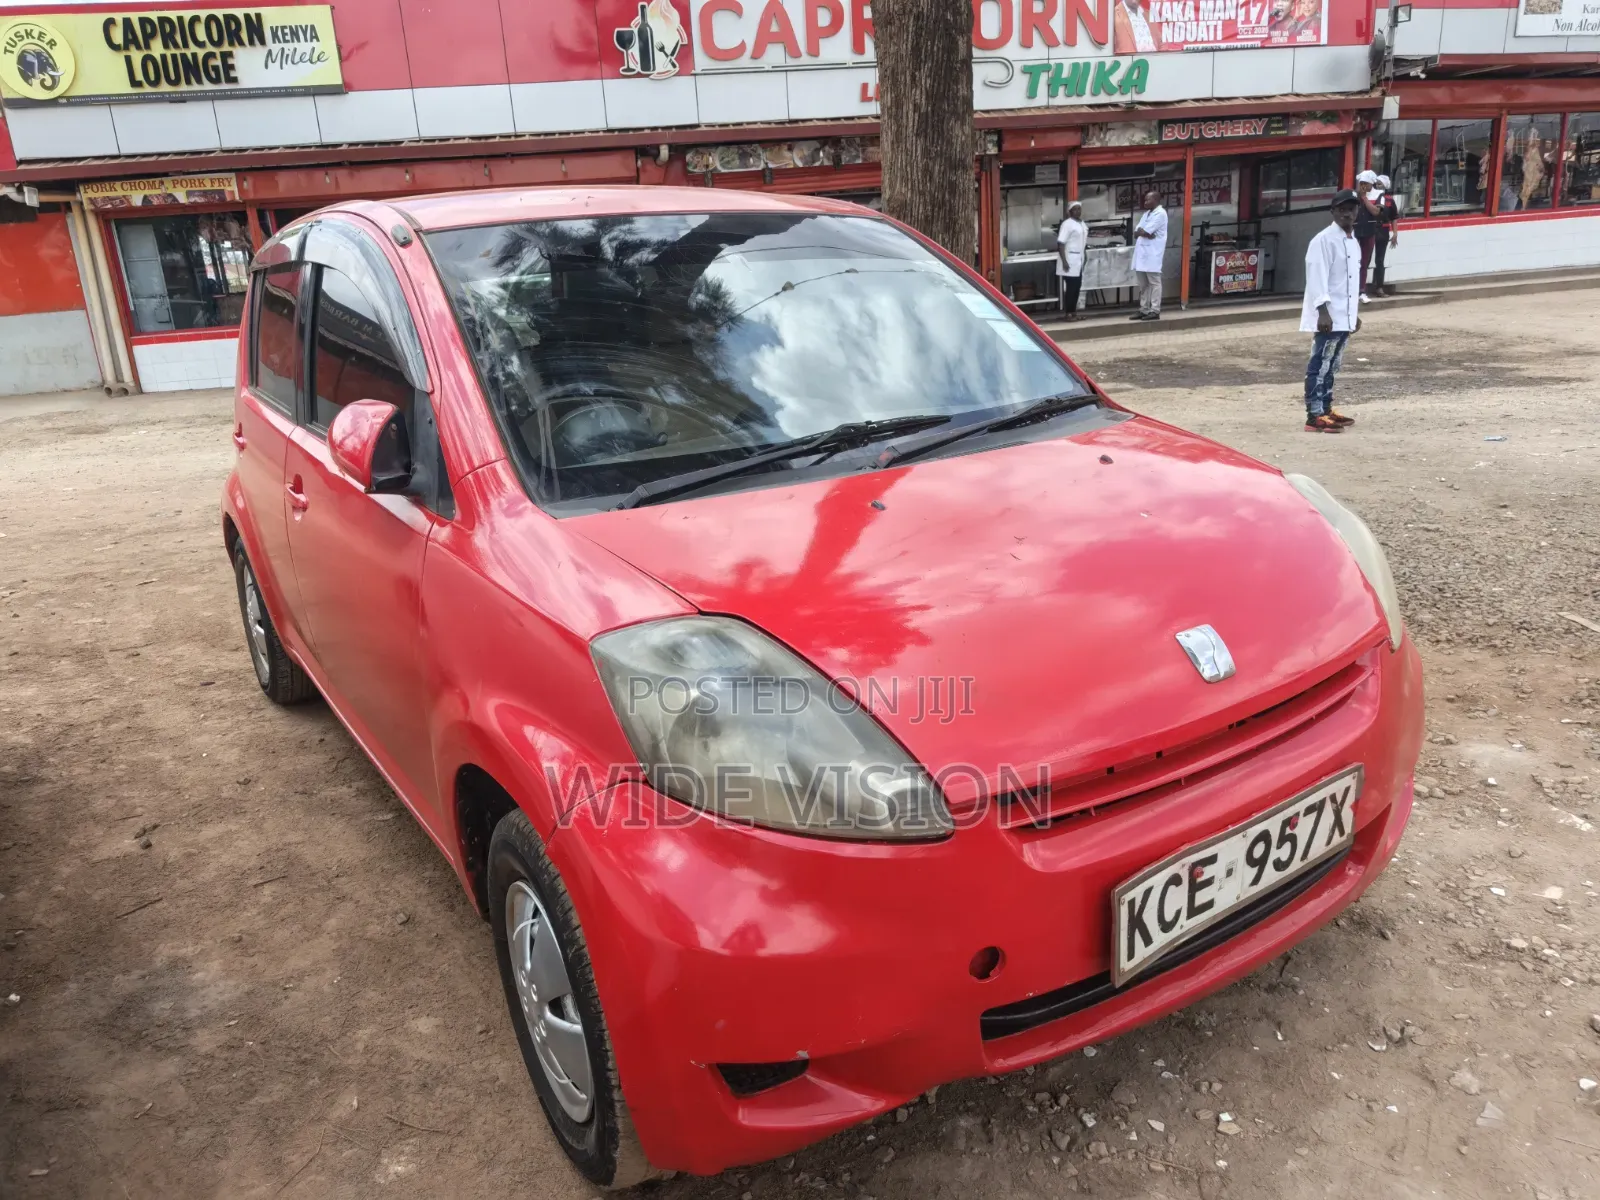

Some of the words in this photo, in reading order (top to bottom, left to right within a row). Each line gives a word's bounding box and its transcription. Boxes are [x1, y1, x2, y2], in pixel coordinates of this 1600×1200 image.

[1151, 0, 1195, 22] KAKA
[1240, 0, 1267, 25] 17
[102, 12, 267, 52] CAPRICORN
[270, 24, 320, 44] KENYA
[1161, 20, 1222, 43] NDUATI
[1238, 27, 1252, 35] OCT
[1552, 18, 1573, 31] Non
[3, 29, 58, 55] TUSKER
[124, 50, 239, 88] LOUNGE
[263, 47, 330, 70] Milele
[1021, 58, 1149, 98] THIKA
[1162, 118, 1269, 140] BUTCHERY
[83, 182, 118, 194] PORK
[172, 178, 208, 189] PORK
[210, 177, 233, 188] FRY
[1127, 853, 1218, 962] KCE
[1245, 785, 1351, 887] 957X
